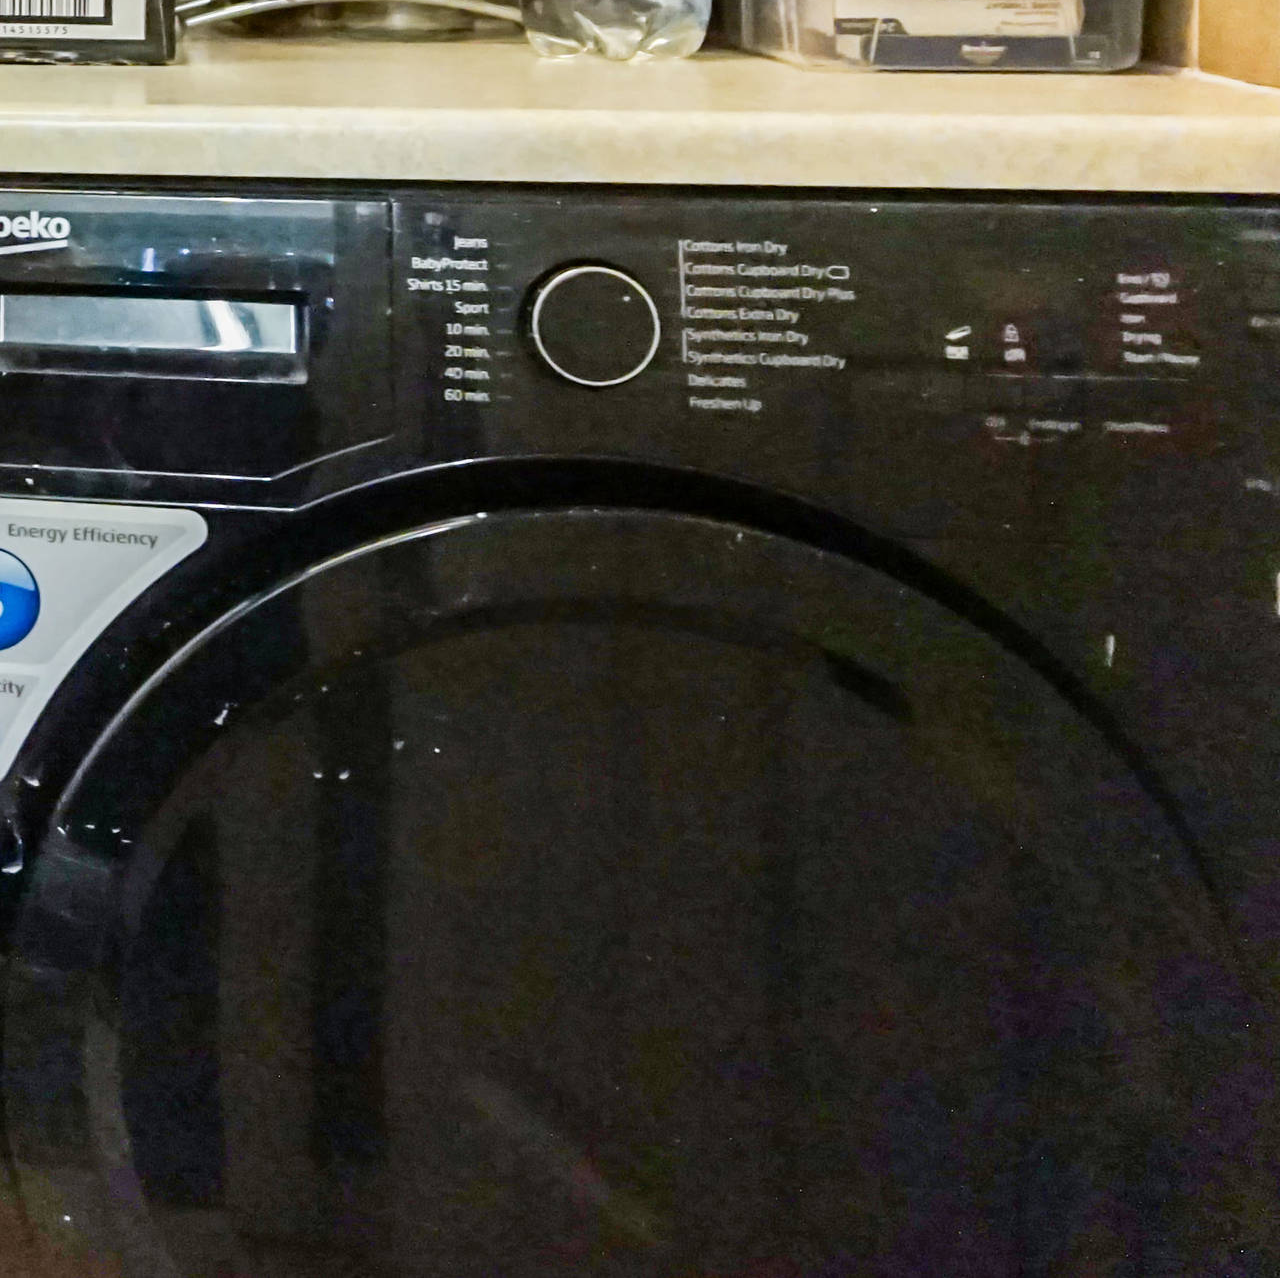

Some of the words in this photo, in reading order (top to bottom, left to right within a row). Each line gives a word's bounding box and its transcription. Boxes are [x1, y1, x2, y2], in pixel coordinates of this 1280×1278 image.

[411, 256, 488, 272] BabyProtect
[407, 278, 444, 291] Shirts
[445, 279, 461, 292] 15
[454, 301, 490, 315] Sport
[445, 323, 462, 336] 10
[444, 344, 463, 358] 20
[444, 367, 463, 380] 40
[444, 389, 463, 402] 60
[8, 523, 68, 543] Energy
[73, 526, 159, 548] Efficiency
